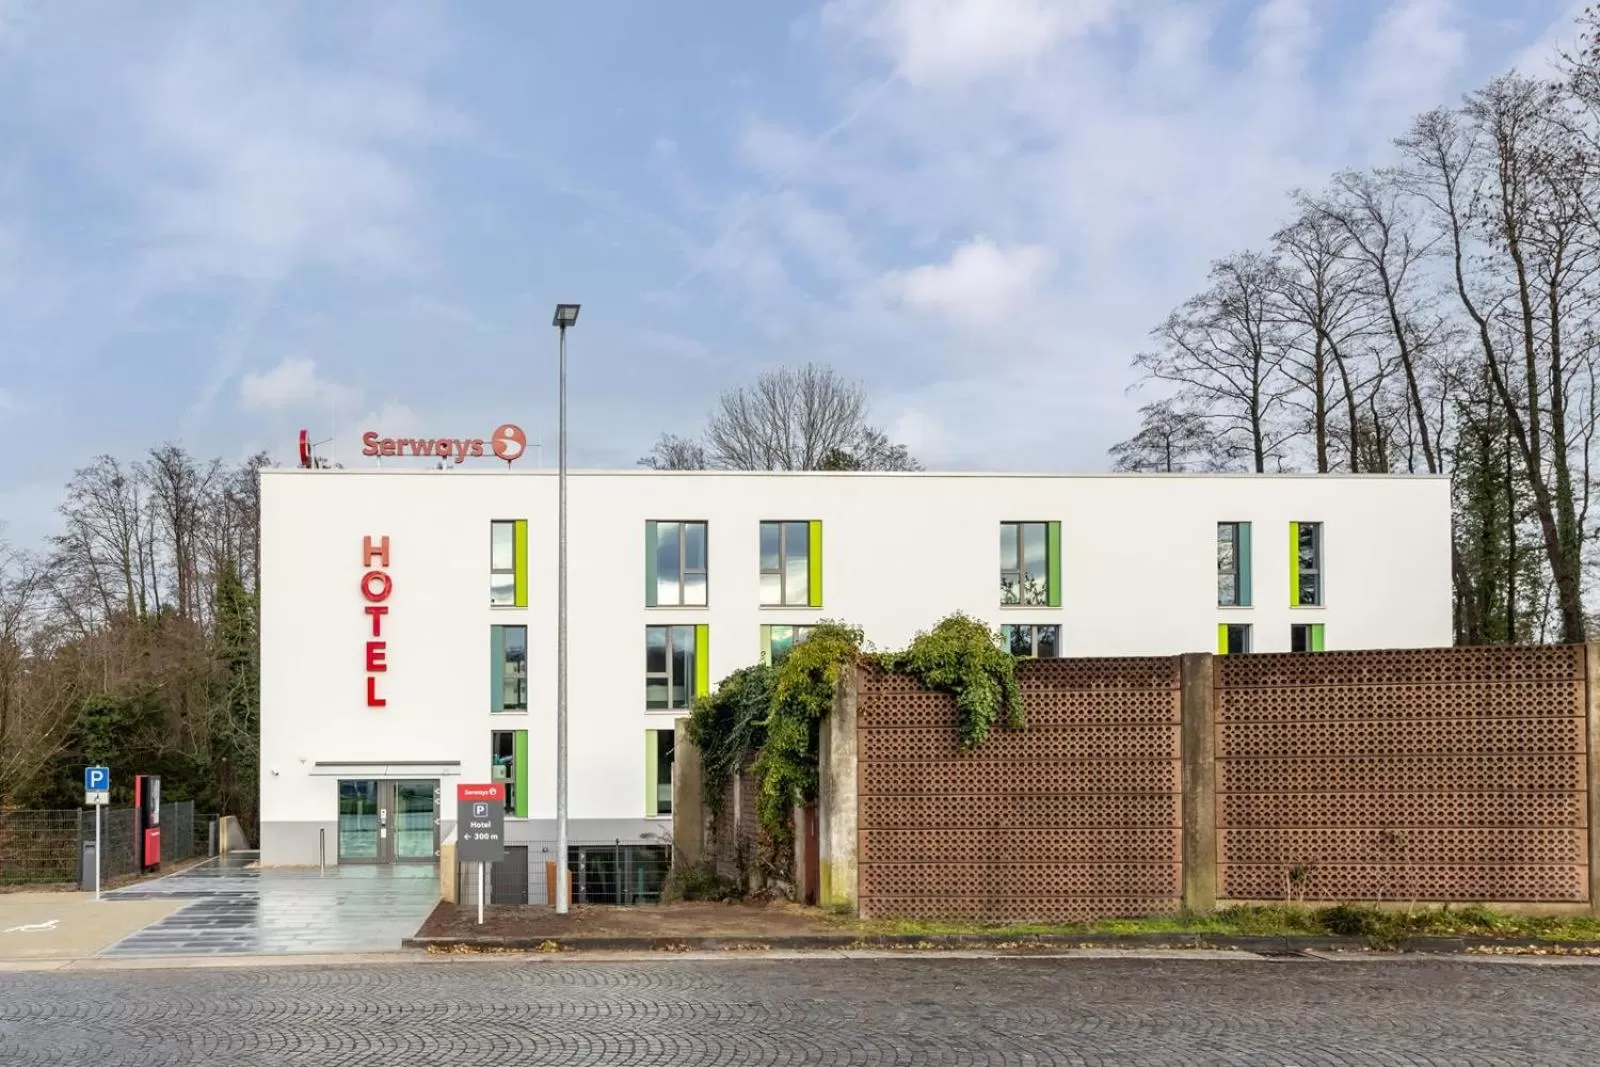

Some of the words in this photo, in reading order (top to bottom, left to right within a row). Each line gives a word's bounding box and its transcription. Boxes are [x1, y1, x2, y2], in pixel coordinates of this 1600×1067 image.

[362, 431, 484, 463] Serways
[360, 535, 393, 707] HOTEL
[91, 770, 103, 787] P
[464, 789, 489, 797] Serways
[476, 805, 485, 815] P
